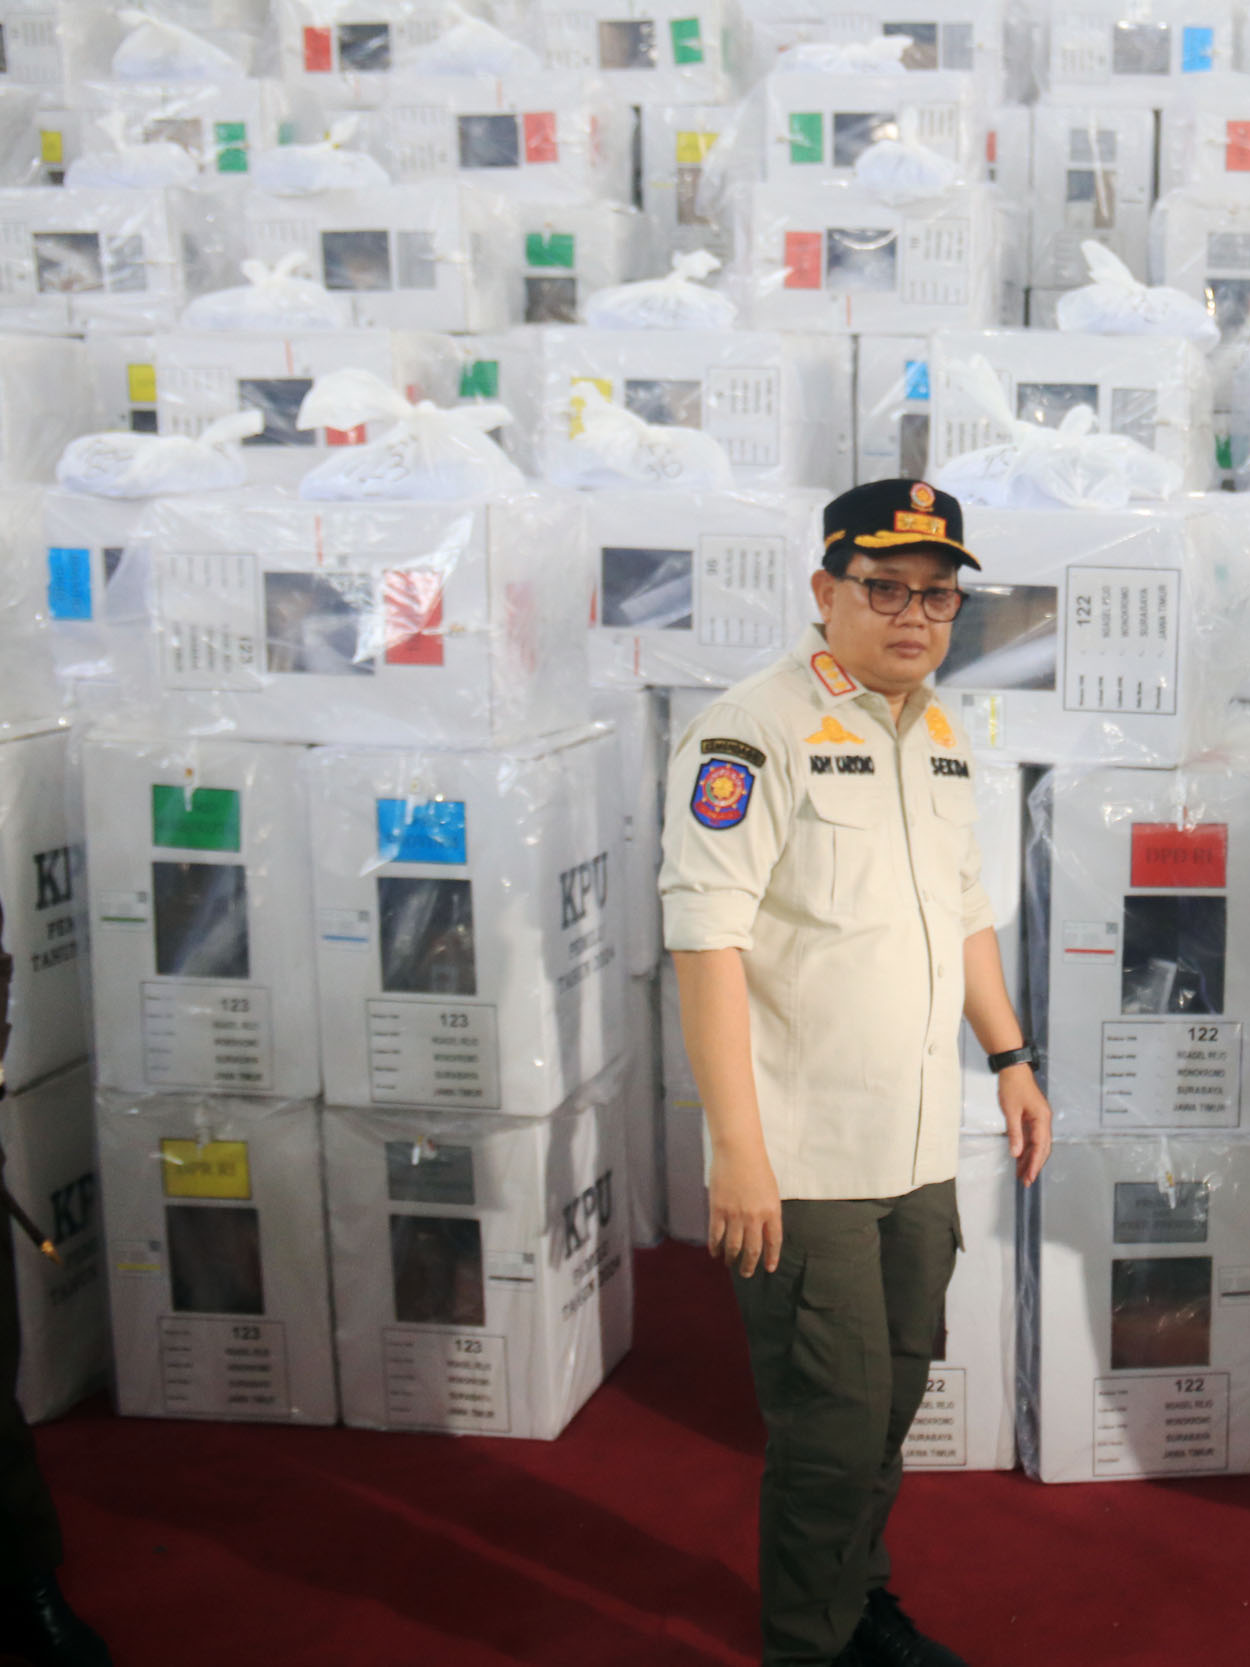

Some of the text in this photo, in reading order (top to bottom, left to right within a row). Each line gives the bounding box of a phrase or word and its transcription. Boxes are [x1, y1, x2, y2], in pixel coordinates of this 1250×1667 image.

[1076, 595, 1092, 627] 122
[559, 851, 608, 931] KPU
[440, 1013, 470, 1028] 123
[1187, 1027, 1220, 1042] 122
[562, 1169, 613, 1260] KPU
[232, 1326, 262, 1341] 123
[455, 1338, 484, 1354] 123
[927, 1379, 946, 1392] 22
[1175, 1378, 1206, 1393] 122
